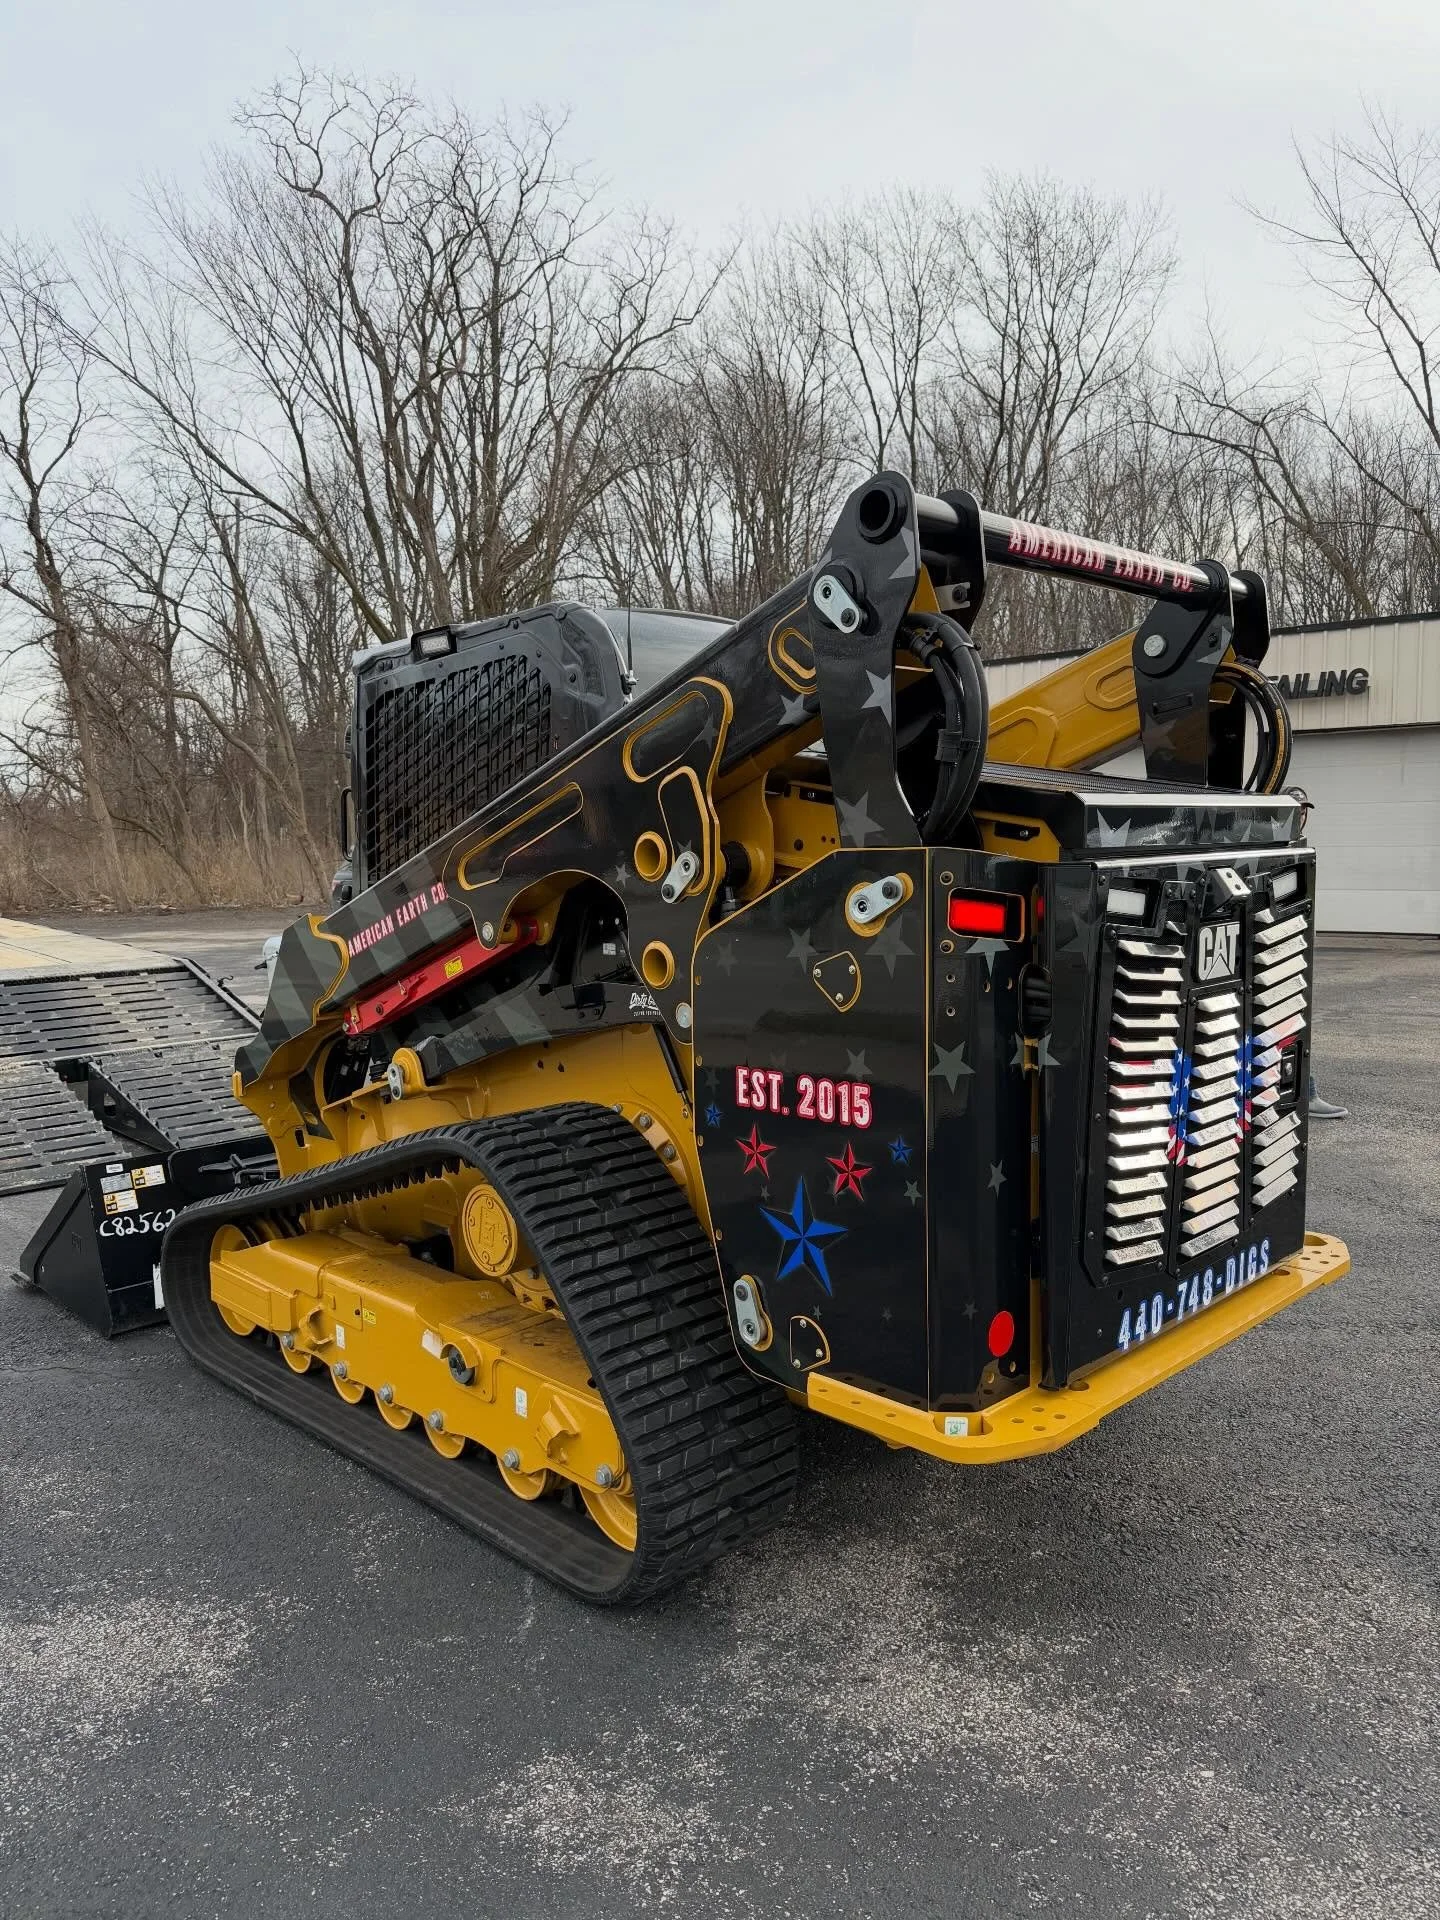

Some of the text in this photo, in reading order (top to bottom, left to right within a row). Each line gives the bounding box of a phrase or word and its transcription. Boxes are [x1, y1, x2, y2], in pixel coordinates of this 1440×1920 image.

[1008, 521, 1105, 572] AMERICAN
[1114, 546, 1165, 587] EARTH
[348, 914, 395, 958] AMERICAN
[395, 892, 429, 927] EARTH
[1198, 923, 1240, 980] CAT
[735, 1066, 872, 1128] EST. 2015
[99, 1208, 176, 1237] C82562
[1117, 1236, 1271, 1351] 440-748-DIGS
